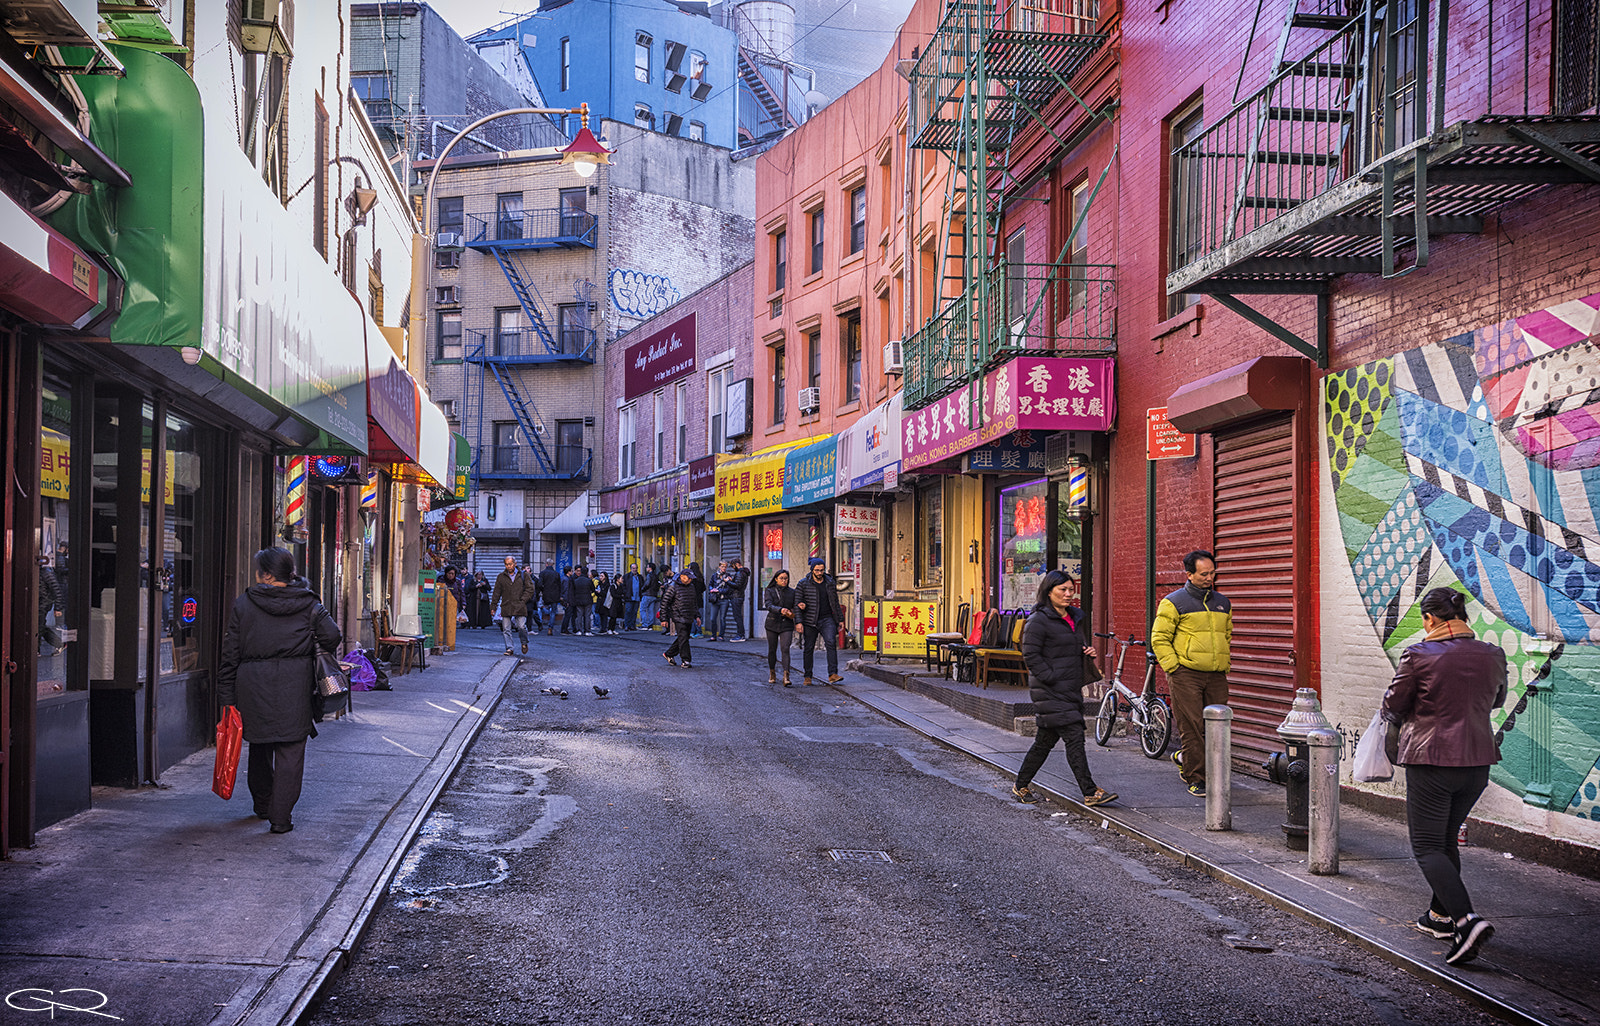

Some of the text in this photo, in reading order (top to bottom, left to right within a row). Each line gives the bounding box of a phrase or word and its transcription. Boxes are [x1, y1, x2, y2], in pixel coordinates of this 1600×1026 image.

[1025, 364, 1095, 394] 香港
[1018, 396, 1104, 417] 男女理髮廳
[866, 425, 881, 453] FedEx
[909, 453, 928, 467] HONG
[929, 445, 948, 461] KONG
[949, 434, 978, 456] BARBER
[980, 421, 1004, 441] SHOP
[724, 503, 735, 513] New
[736, 500, 750, 511] China
[752, 498, 770, 509] Beauty
[889, 605, 921, 620] 美奇
[885, 621, 926, 636] 理髮店
